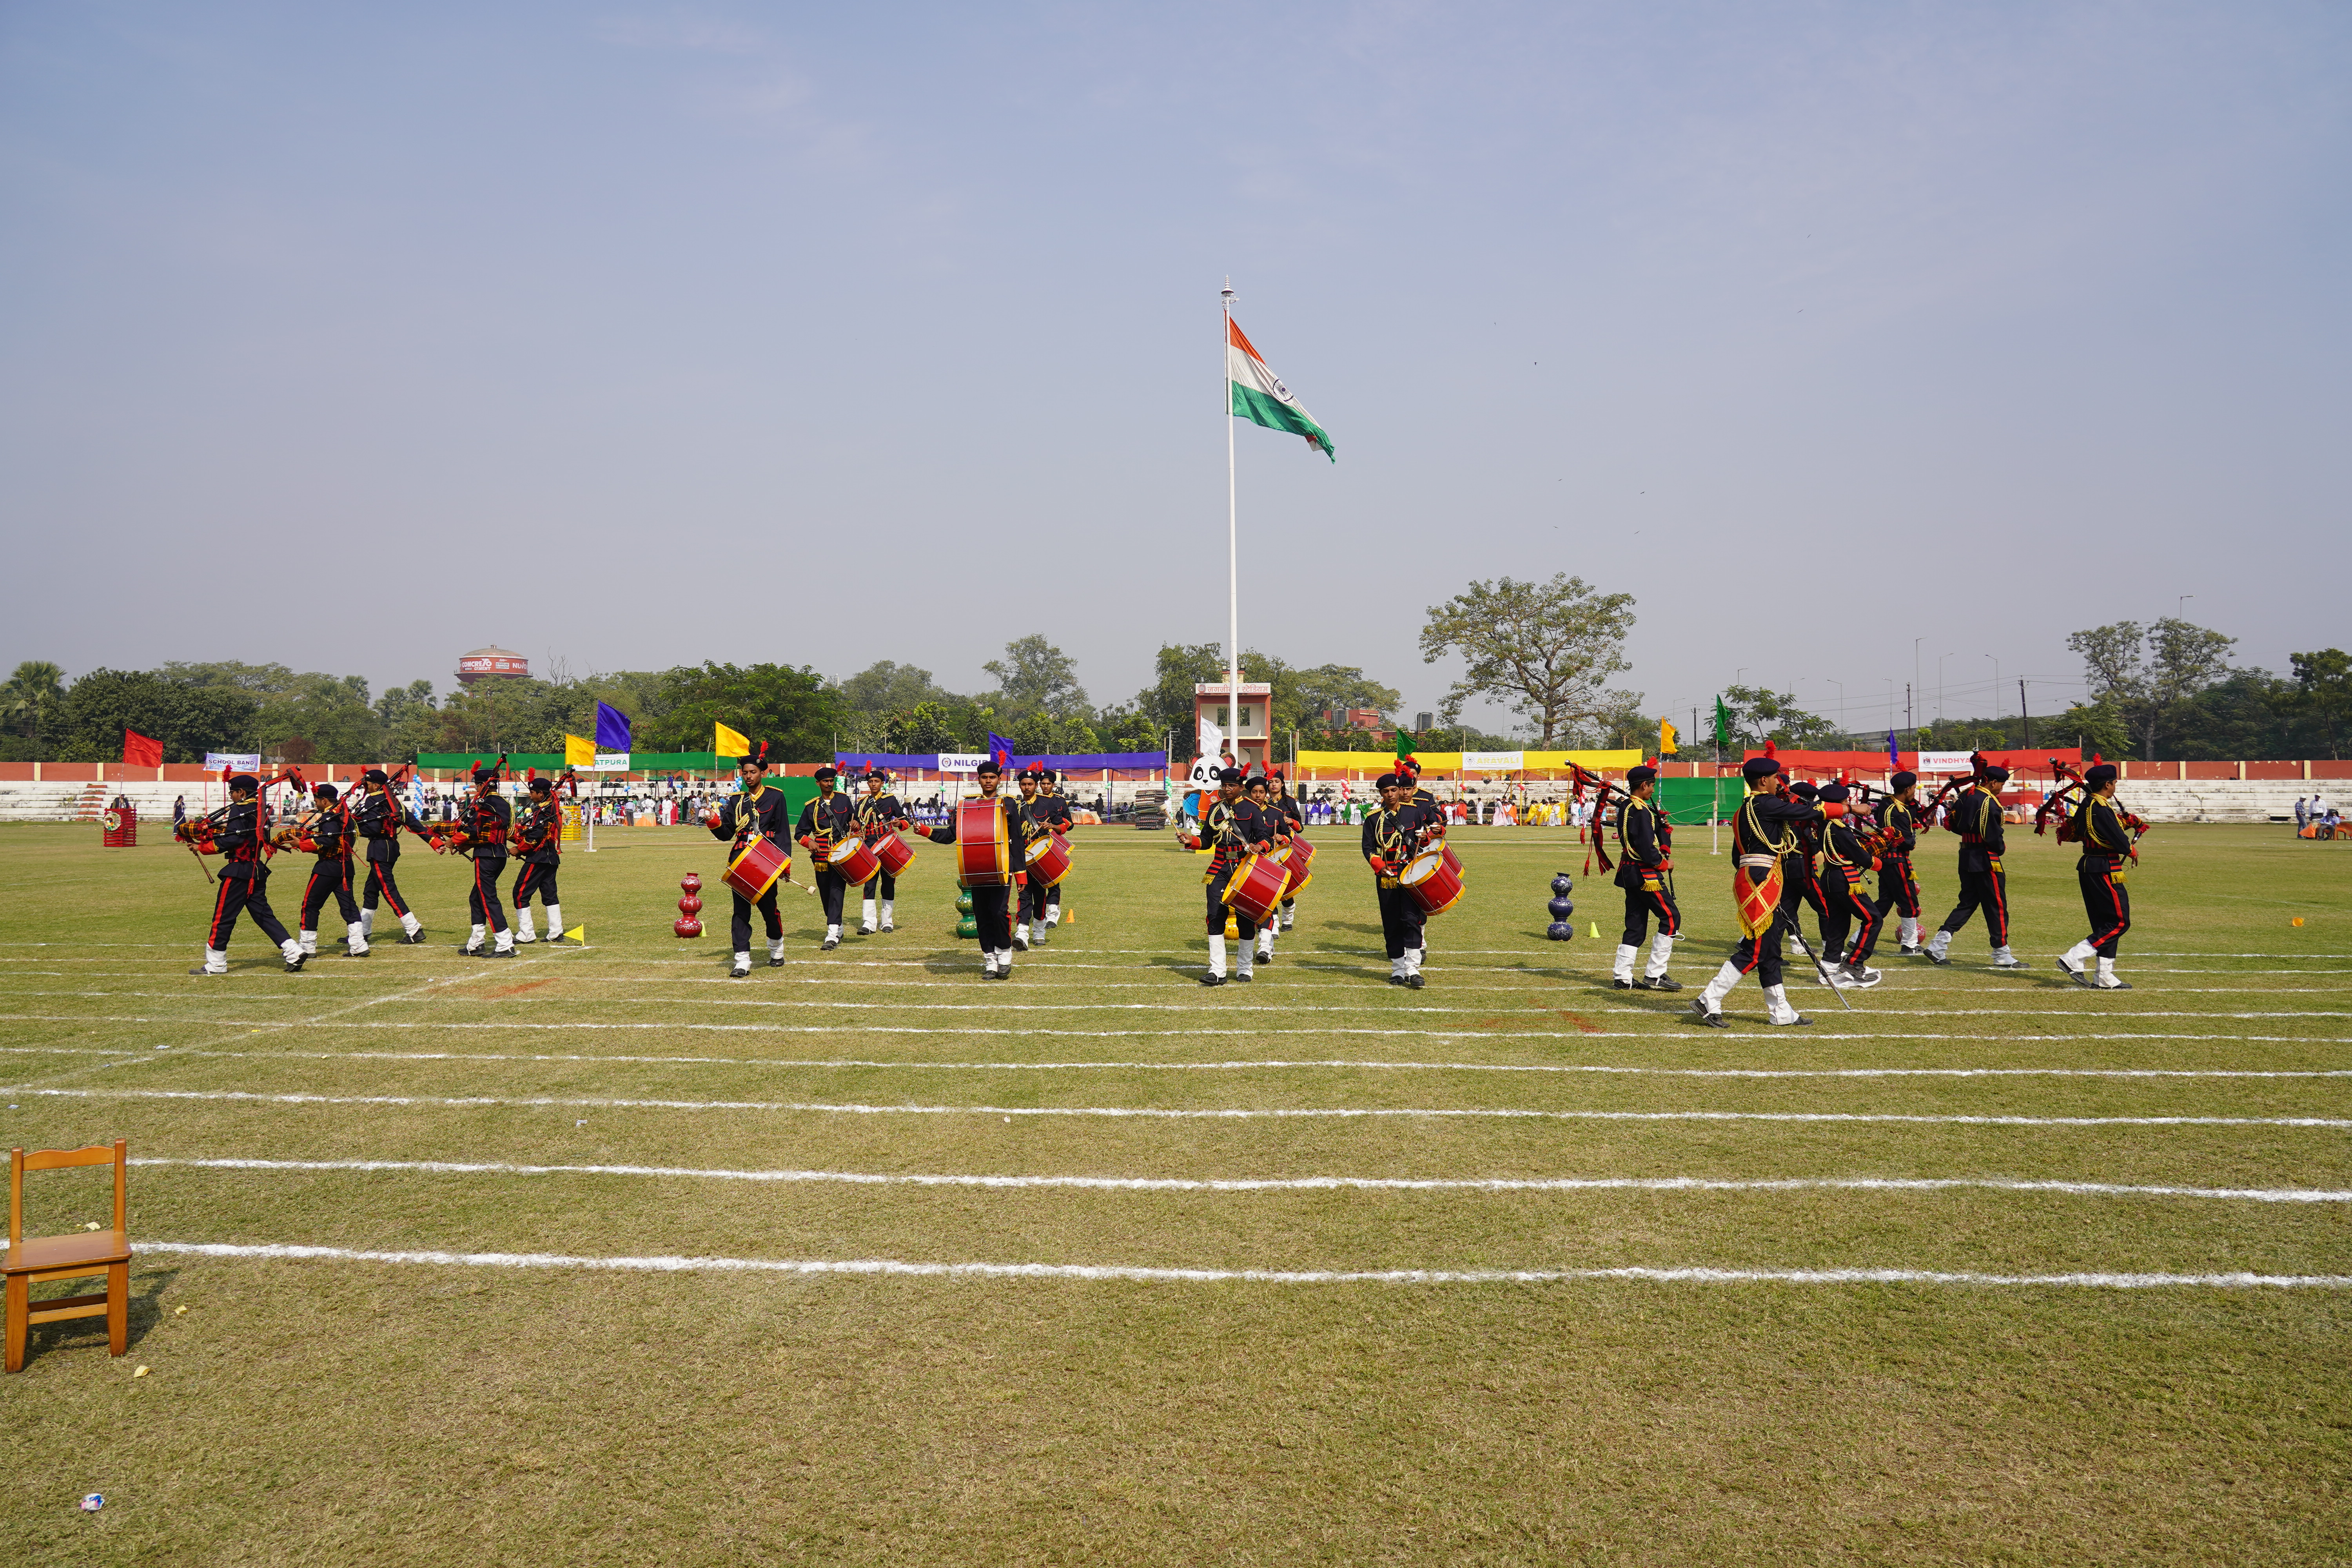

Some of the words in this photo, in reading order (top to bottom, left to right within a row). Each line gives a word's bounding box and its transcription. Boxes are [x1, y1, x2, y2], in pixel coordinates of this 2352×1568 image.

[462, 658, 492, 668] CONCRETO
[1207, 684, 1240, 692] जगजी
[1242, 684, 1269, 692] स्टेडियम
